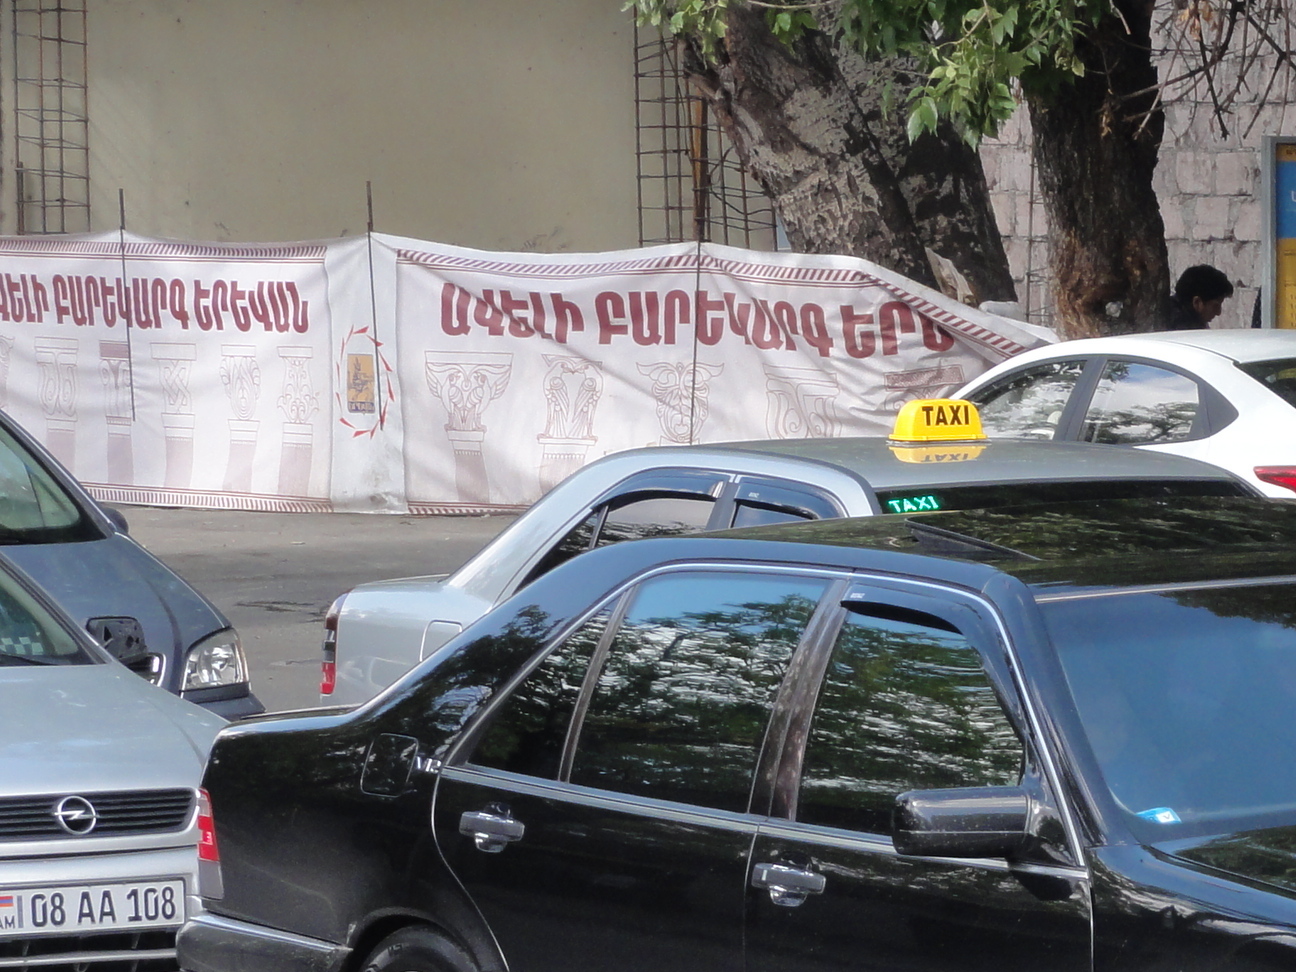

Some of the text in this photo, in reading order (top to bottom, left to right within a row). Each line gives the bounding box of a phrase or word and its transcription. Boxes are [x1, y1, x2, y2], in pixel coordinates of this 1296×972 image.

[52, 274, 190, 331] ԲԱՐԵԿԱՐԳ
[193, 279, 310, 334] ԵՐԵՎԱՆ
[440, 282, 586, 345] ԱՎԵԼԻ
[594, 289, 835, 358] ԲԱՐԵԿԱՐԳ
[921, 404, 971, 427] TAXI
[888, 494, 940, 514] TAXI
[31, 886, 177, 929] 08 AA 108
